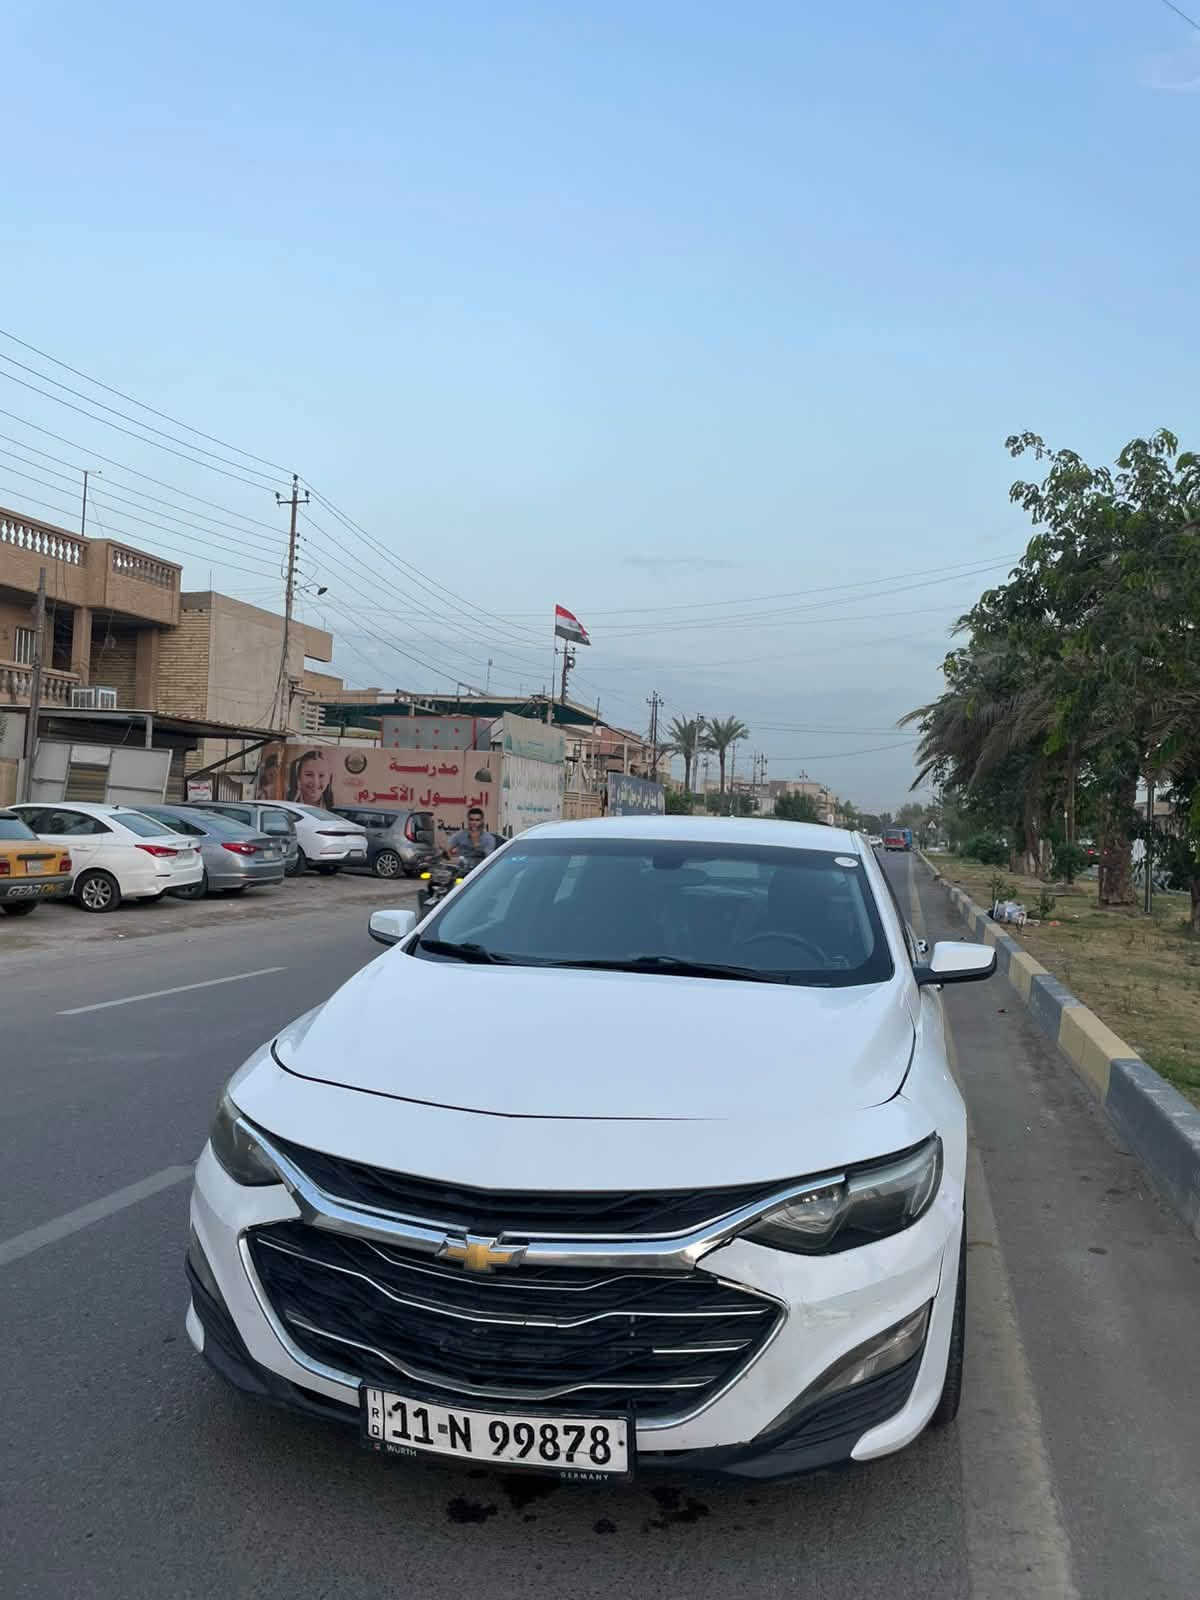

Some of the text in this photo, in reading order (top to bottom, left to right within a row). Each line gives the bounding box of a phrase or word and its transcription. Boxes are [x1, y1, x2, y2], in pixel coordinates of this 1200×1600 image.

[389, 757, 459, 776] مدرسة
[420, 788, 487, 807] الرسول
[488, 1420, 611, 1465] 99878
